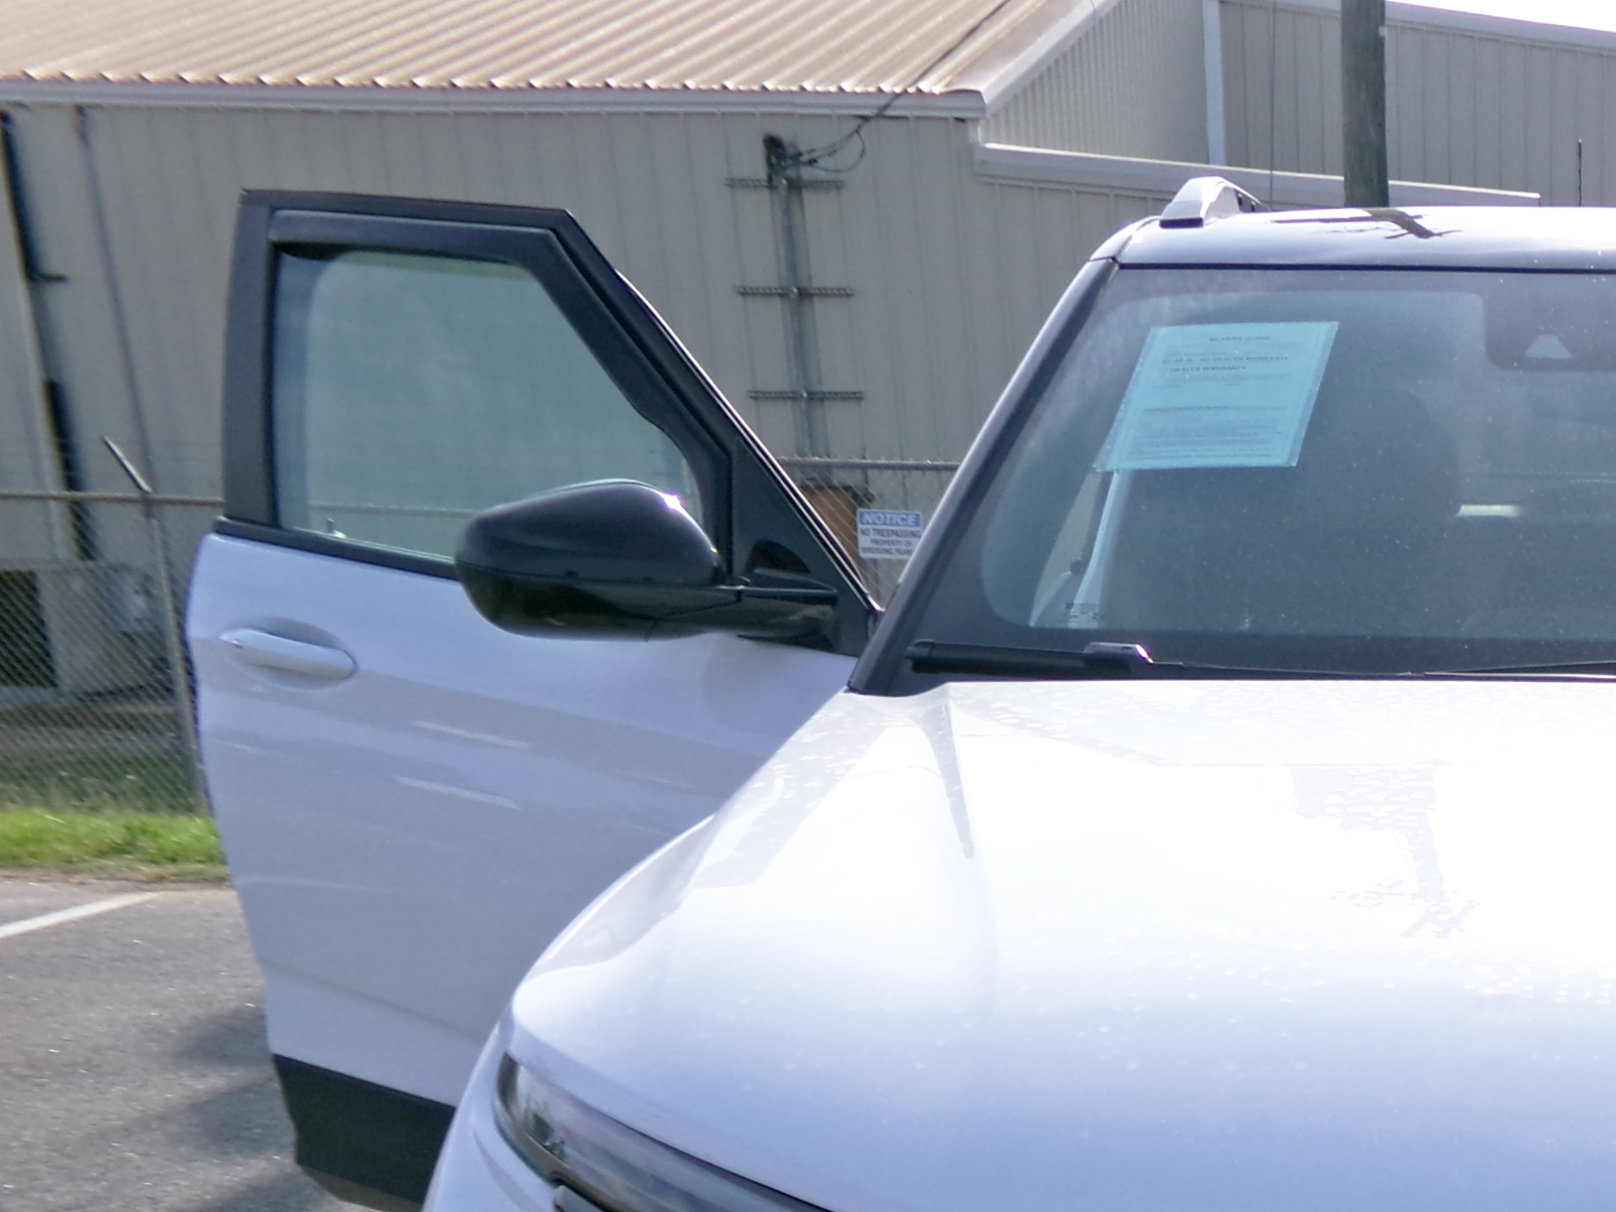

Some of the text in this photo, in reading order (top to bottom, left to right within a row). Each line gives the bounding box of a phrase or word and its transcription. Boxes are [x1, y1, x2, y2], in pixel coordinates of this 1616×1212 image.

[862, 512, 917, 526] NOTICE
[860, 528, 922, 539] NO TRESPASSING
[870, 538, 903, 547] PROPERTY
